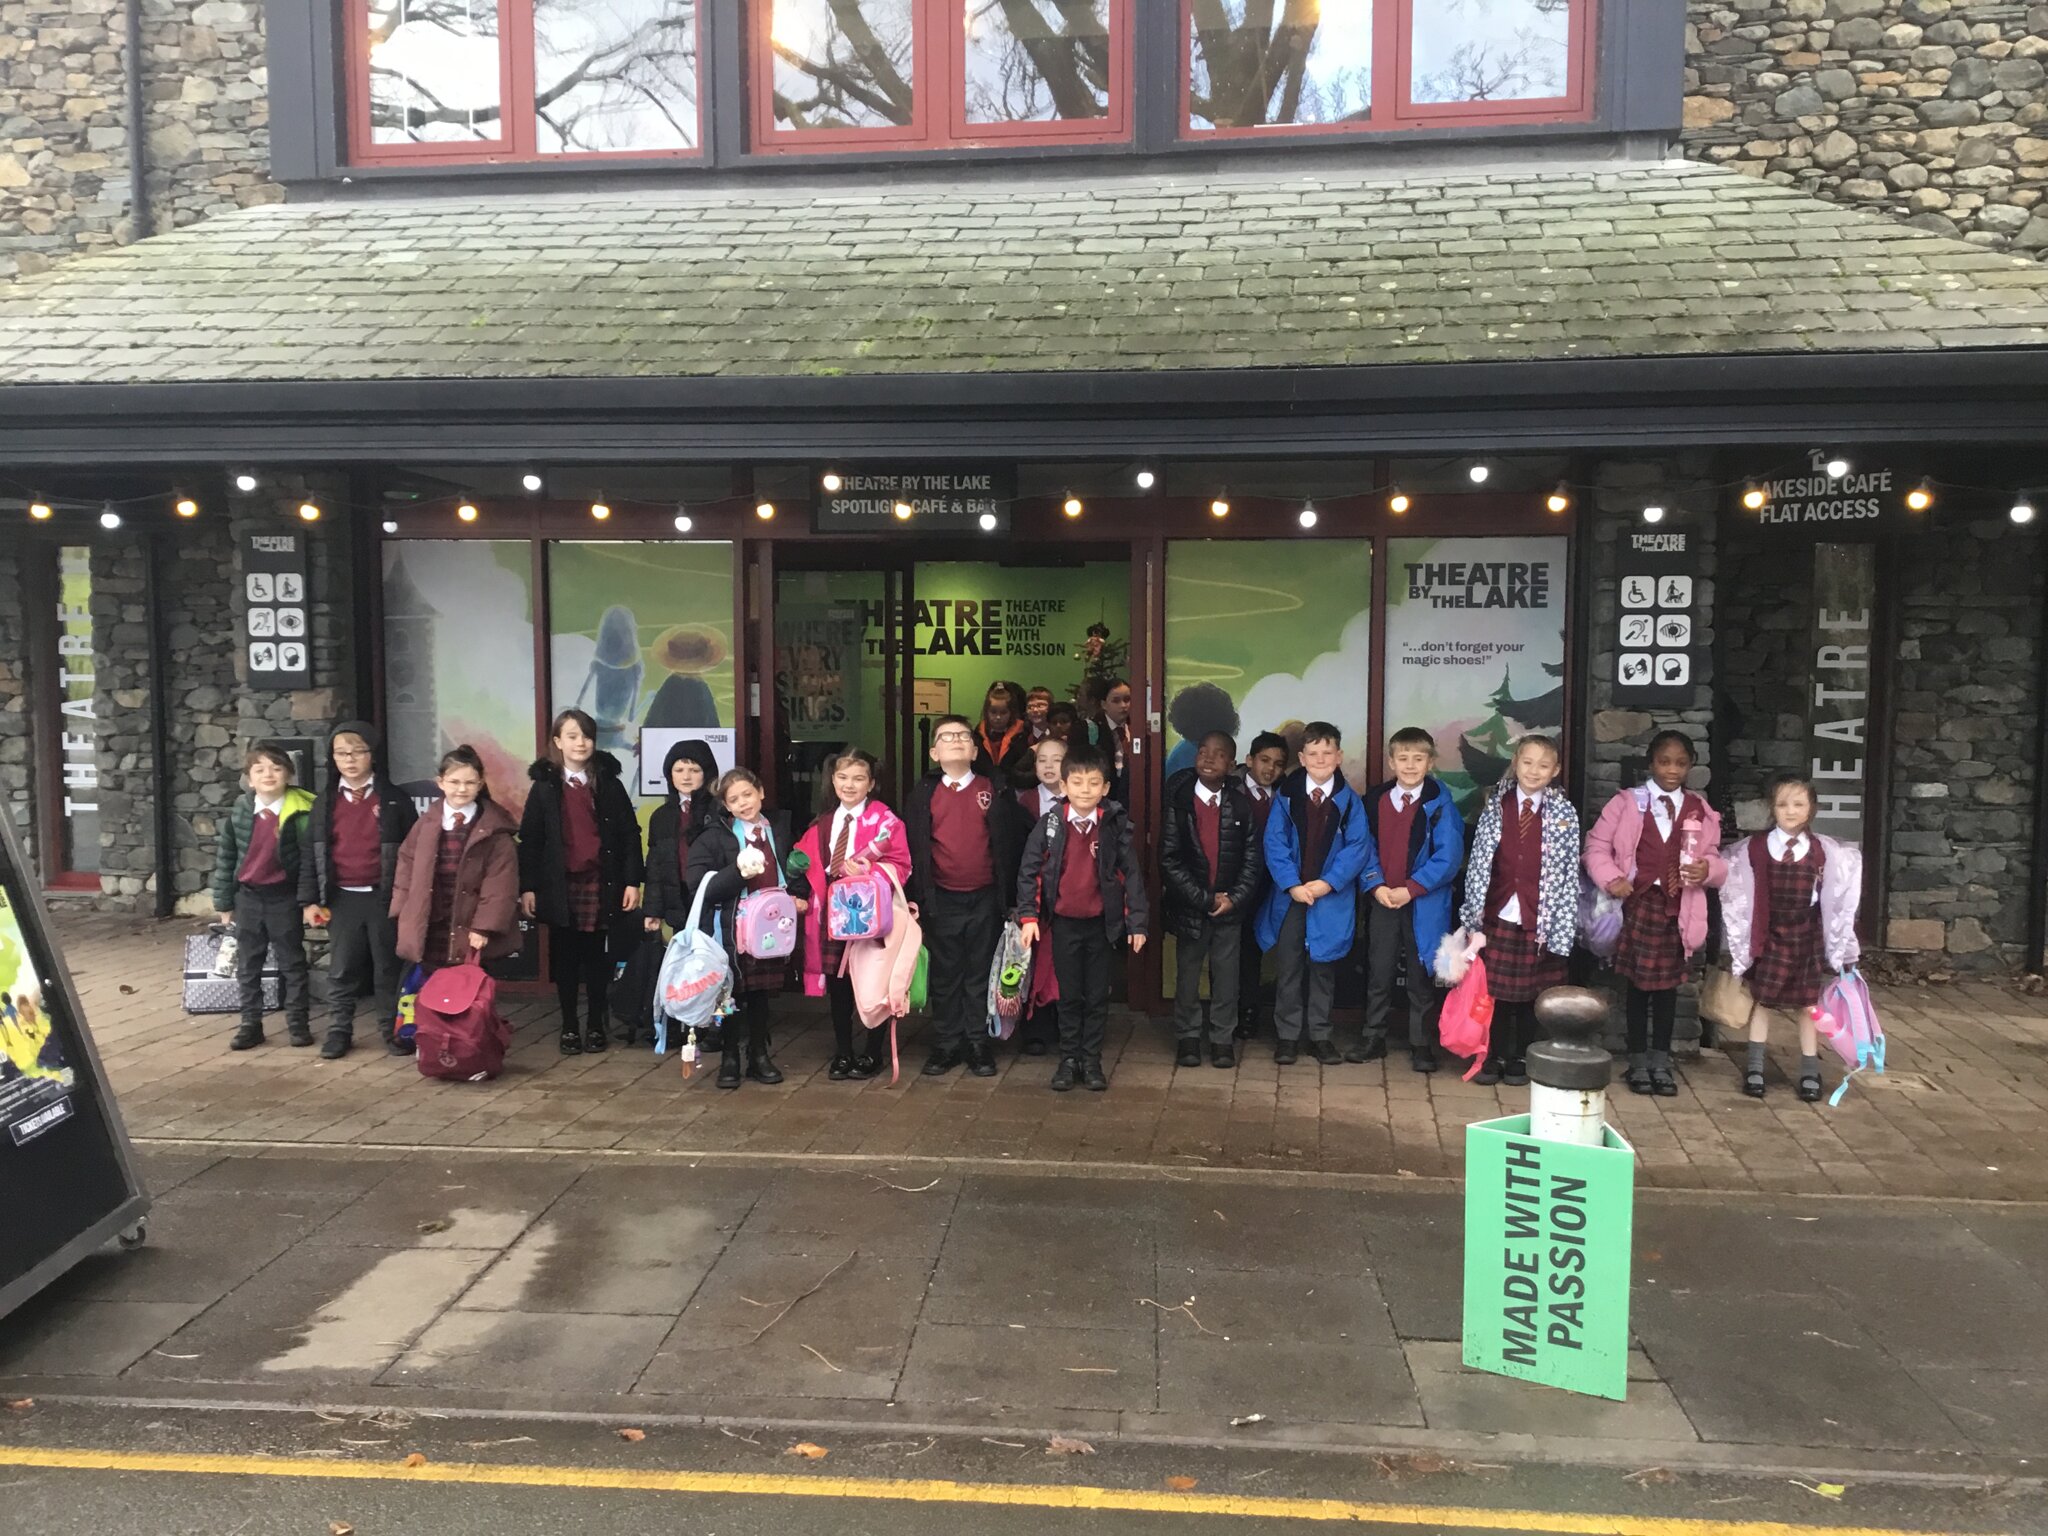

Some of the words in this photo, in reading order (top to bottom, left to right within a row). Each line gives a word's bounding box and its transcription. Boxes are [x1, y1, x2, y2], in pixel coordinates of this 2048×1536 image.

[839, 476, 898, 490] THEATRE
[902, 475, 920, 490] BY
[923, 475, 949, 490] THE
[953, 475, 991, 490] LAKE
[1760, 476, 1839, 499] AKESIDE
[1842, 467, 1892, 494] CAFÉ
[831, 499, 908, 514] SPOTLIGH
[911, 494, 948, 514] CAFÉ
[950, 499, 963, 514] &
[1759, 502, 1801, 524] FLAT
[1803, 497, 1880, 522] ACCESS
[1631, 534, 1686, 543] THEATRE
[1654, 542, 1686, 551] LAKE
[1404, 562, 1549, 586] THEATRE
[1005, 600, 1066, 612] THEATRE
[1408, 586, 1432, 599] BY
[1430, 595, 1465, 608] THE
[1465, 586, 1549, 608] LAKE
[1005, 614, 1047, 627] MADE
[1005, 628, 1040, 641] WITH
[1005, 643, 1066, 656] PASSION
[1455, 641, 1494, 655] forget
[1494, 643, 1525, 655] your
[1402, 655, 1443, 667] magic
[56, 602, 99, 817] THEATRE
[1812, 608, 1870, 849] HEATRE
[1504, 1141, 1541, 1239] WITH
[1547, 1174, 1587, 1351] PASSION
[1502, 1247, 1540, 1367] MADE
